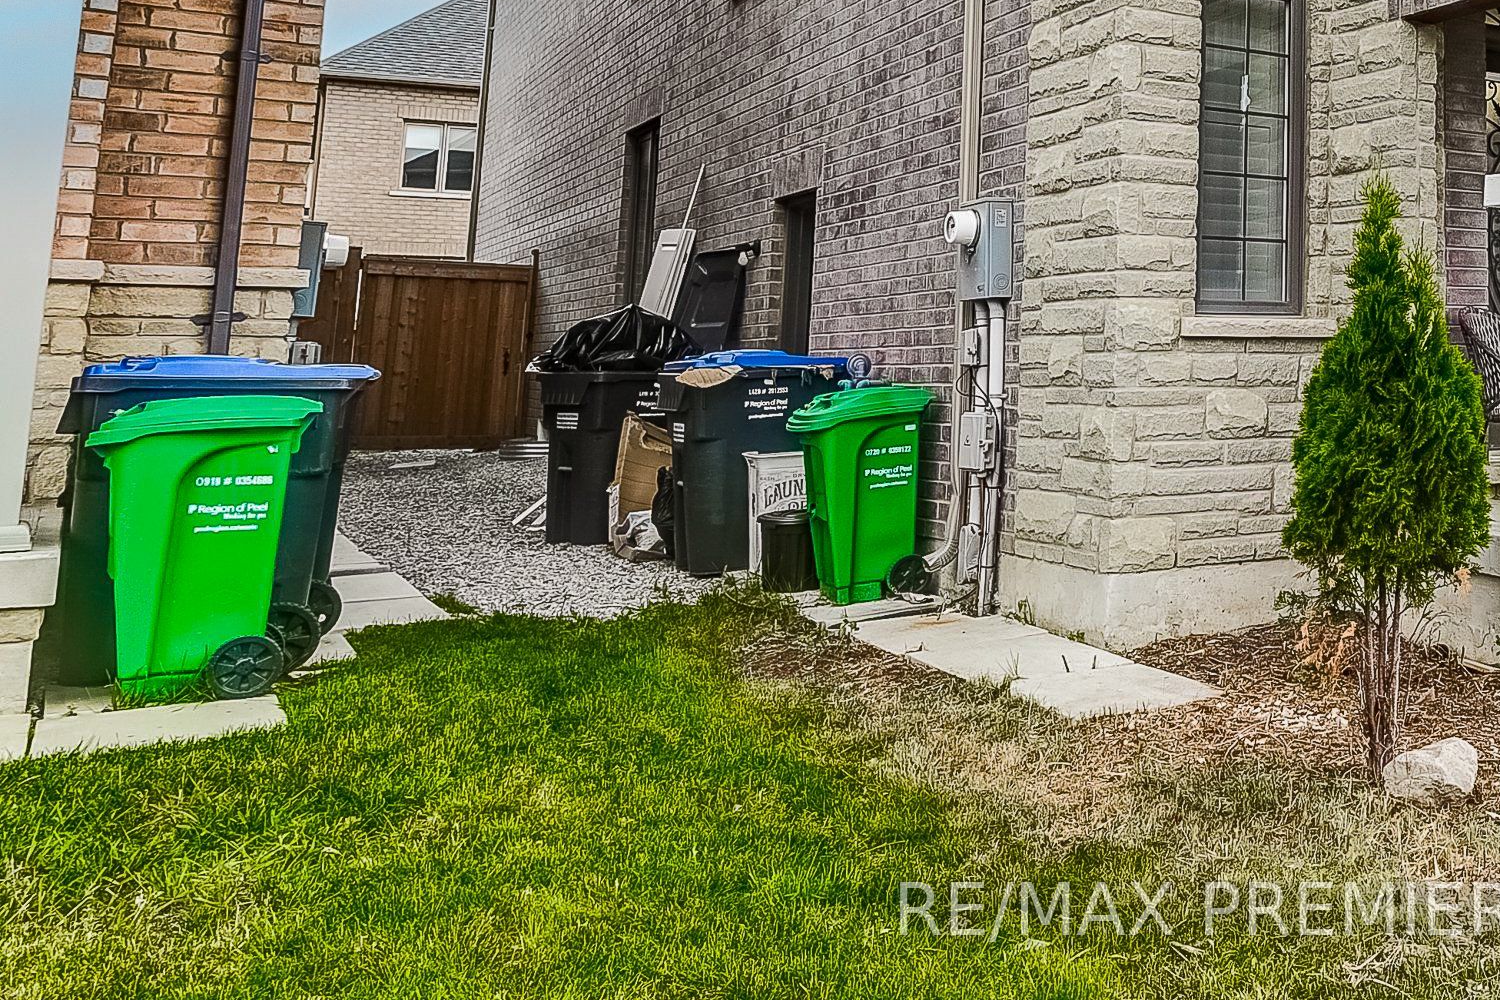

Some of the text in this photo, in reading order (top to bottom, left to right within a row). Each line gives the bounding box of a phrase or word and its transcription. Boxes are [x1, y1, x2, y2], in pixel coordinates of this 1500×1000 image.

[763, 478, 806, 509] LAUN
[197, 504, 235, 515] Region
[247, 501, 269, 511] Peel
